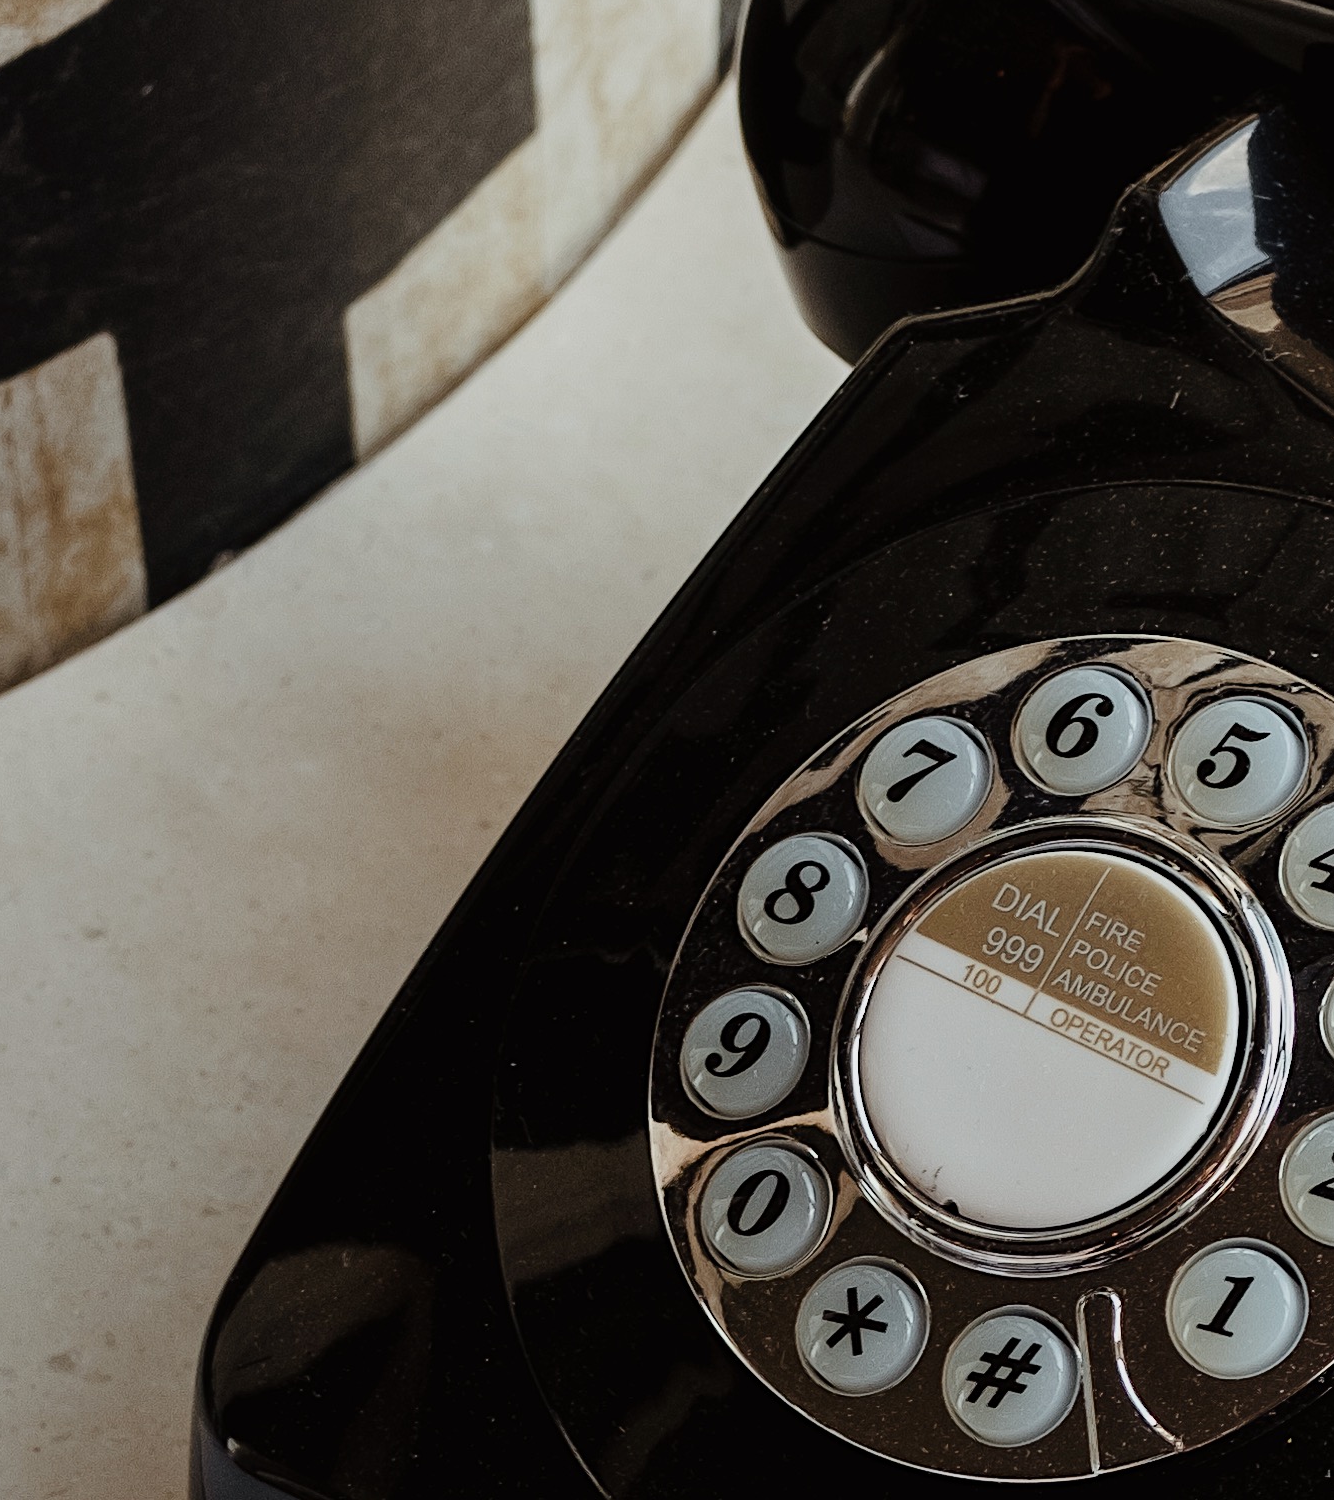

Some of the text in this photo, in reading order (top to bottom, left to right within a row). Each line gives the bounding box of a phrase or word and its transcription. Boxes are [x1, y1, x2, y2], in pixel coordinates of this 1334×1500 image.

[1046, 693, 1114, 758] 6
[1197, 723, 1270, 789] 5
[886, 738, 957, 802] 7
[764, 860, 831, 925] 8
[992, 883, 1059, 937] DIAL
[982, 927, 1044, 972] 999
[1085, 912, 1145, 953] FIRE
[1069, 939, 1162, 996] POLICE
[964, 964, 1170, 1078] 100 OPERATOR
[1051, 969, 1208, 1053] AMBULANCE
[705, 1012, 771, 1078] 9
[727, 1169, 790, 1236] 0
[1197, 1275, 1255, 1338] 1
